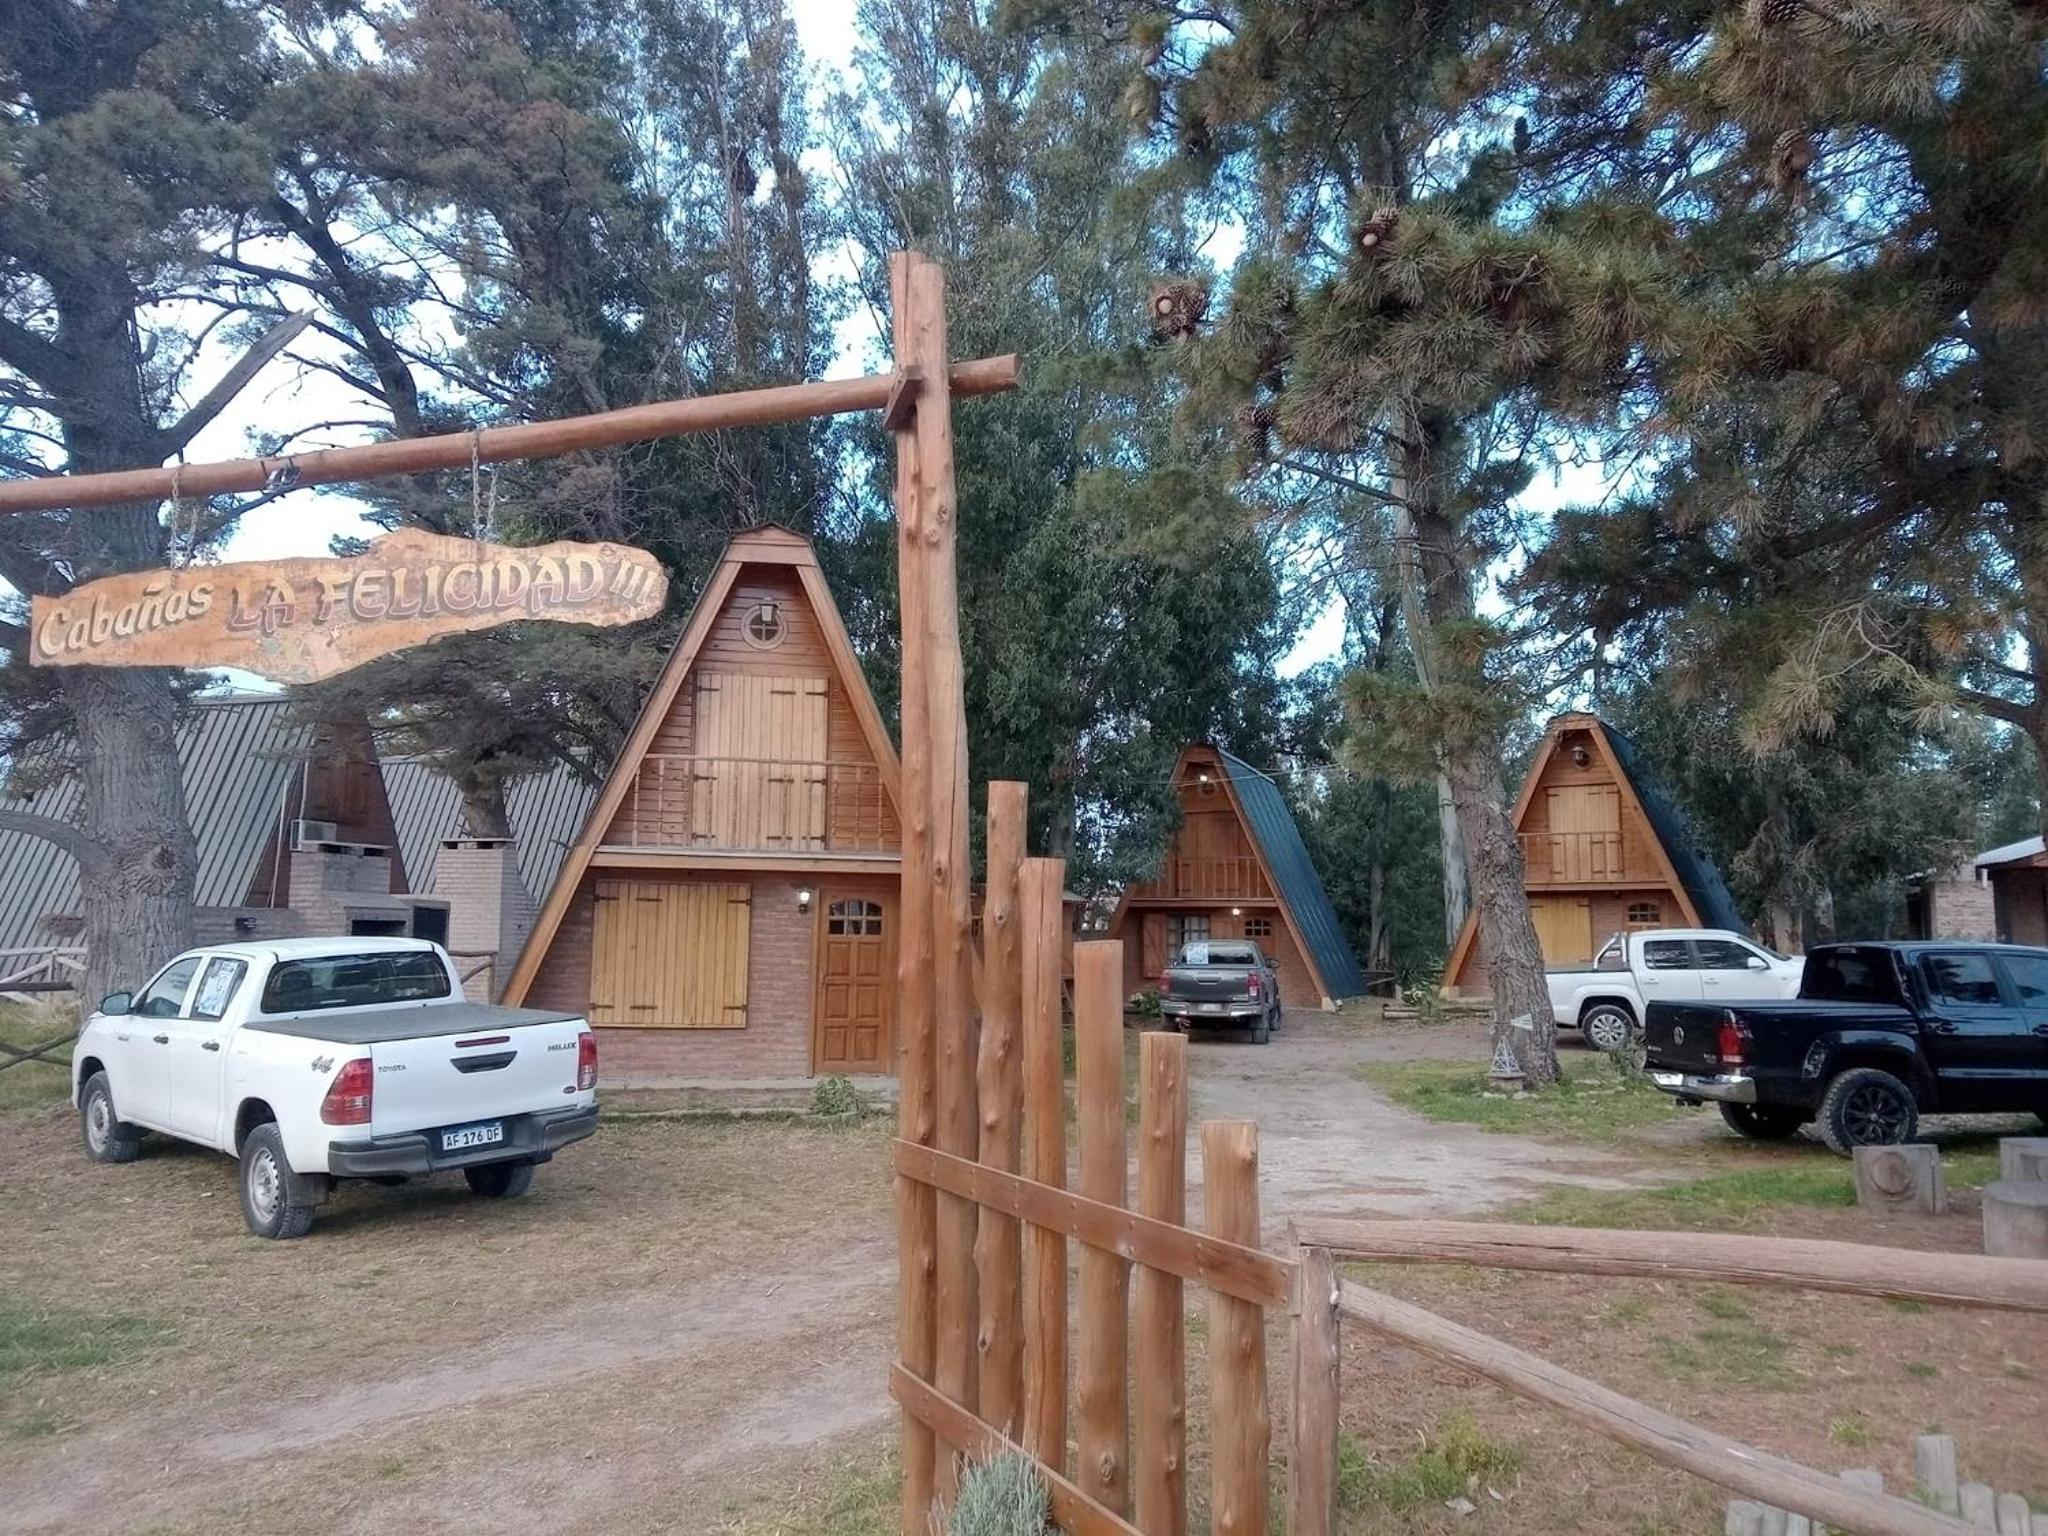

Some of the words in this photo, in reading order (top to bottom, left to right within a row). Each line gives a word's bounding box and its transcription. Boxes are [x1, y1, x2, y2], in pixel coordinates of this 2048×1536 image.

[39, 580, 214, 657] Cabañas
[228, 577, 295, 633] LA
[316, 554, 603, 621] FELICIDAD
[548, 1042, 576, 1051] HILUX
[378, 1064, 406, 1073] TOYOTA
[446, 1134, 460, 1148] AF
[462, 1130, 483, 1145] 176
